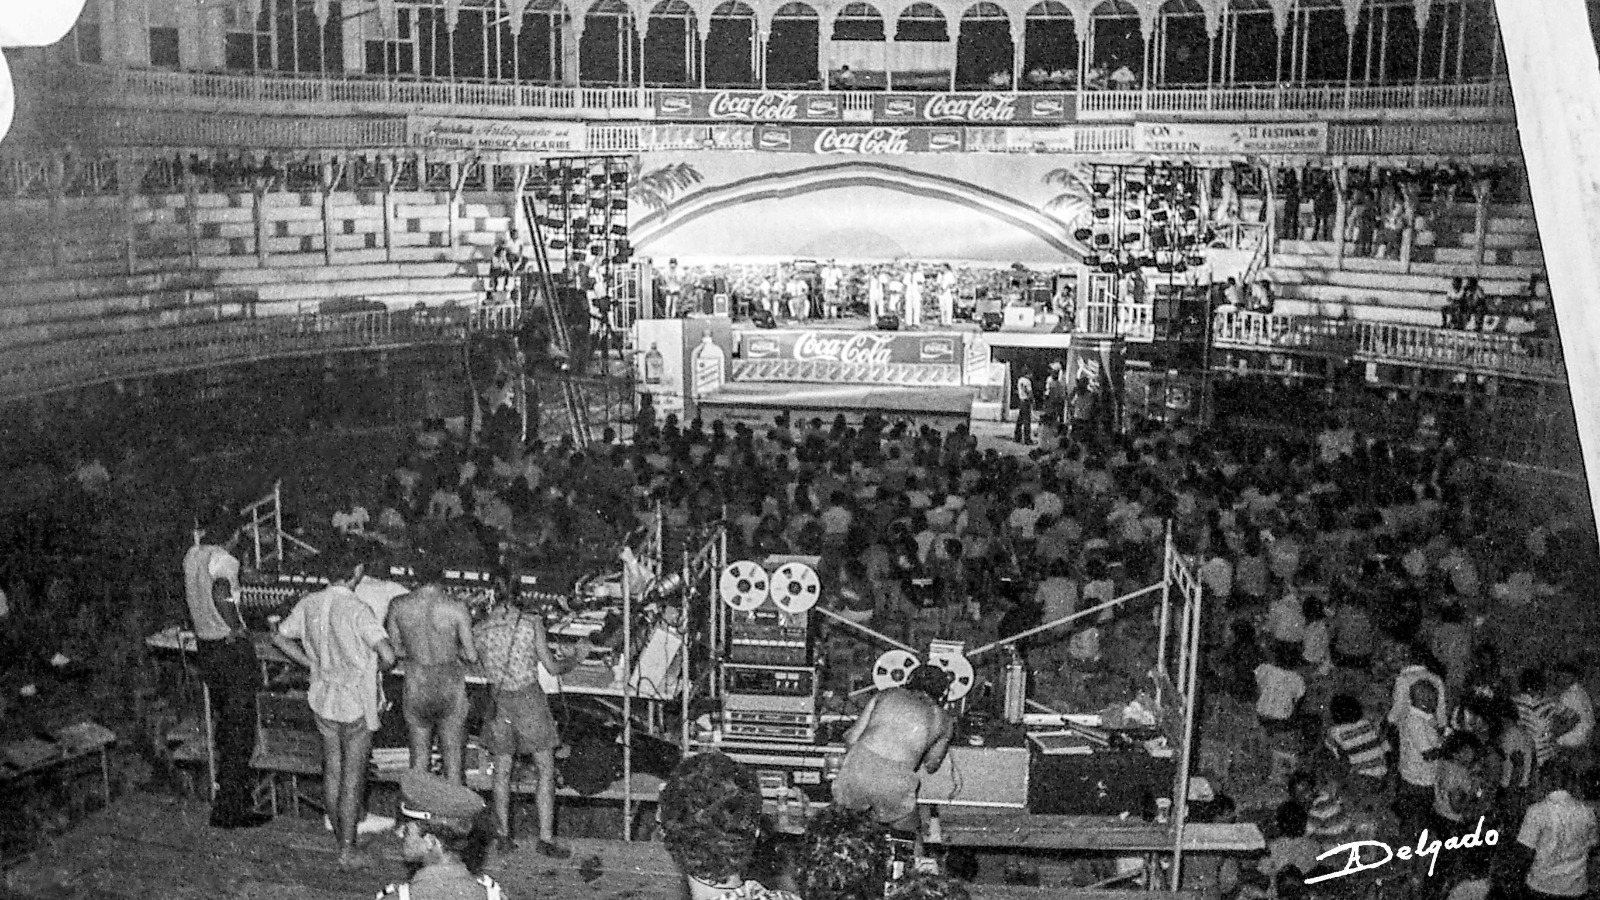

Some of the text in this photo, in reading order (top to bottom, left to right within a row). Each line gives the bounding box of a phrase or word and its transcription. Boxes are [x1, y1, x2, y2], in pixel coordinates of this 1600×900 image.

[709, 91, 798, 120] Coca-Cola
[923, 92, 1016, 121] Coca-Cola
[814, 127, 910, 154] Coca-Cola
[793, 332, 896, 364] Coca-Cola
